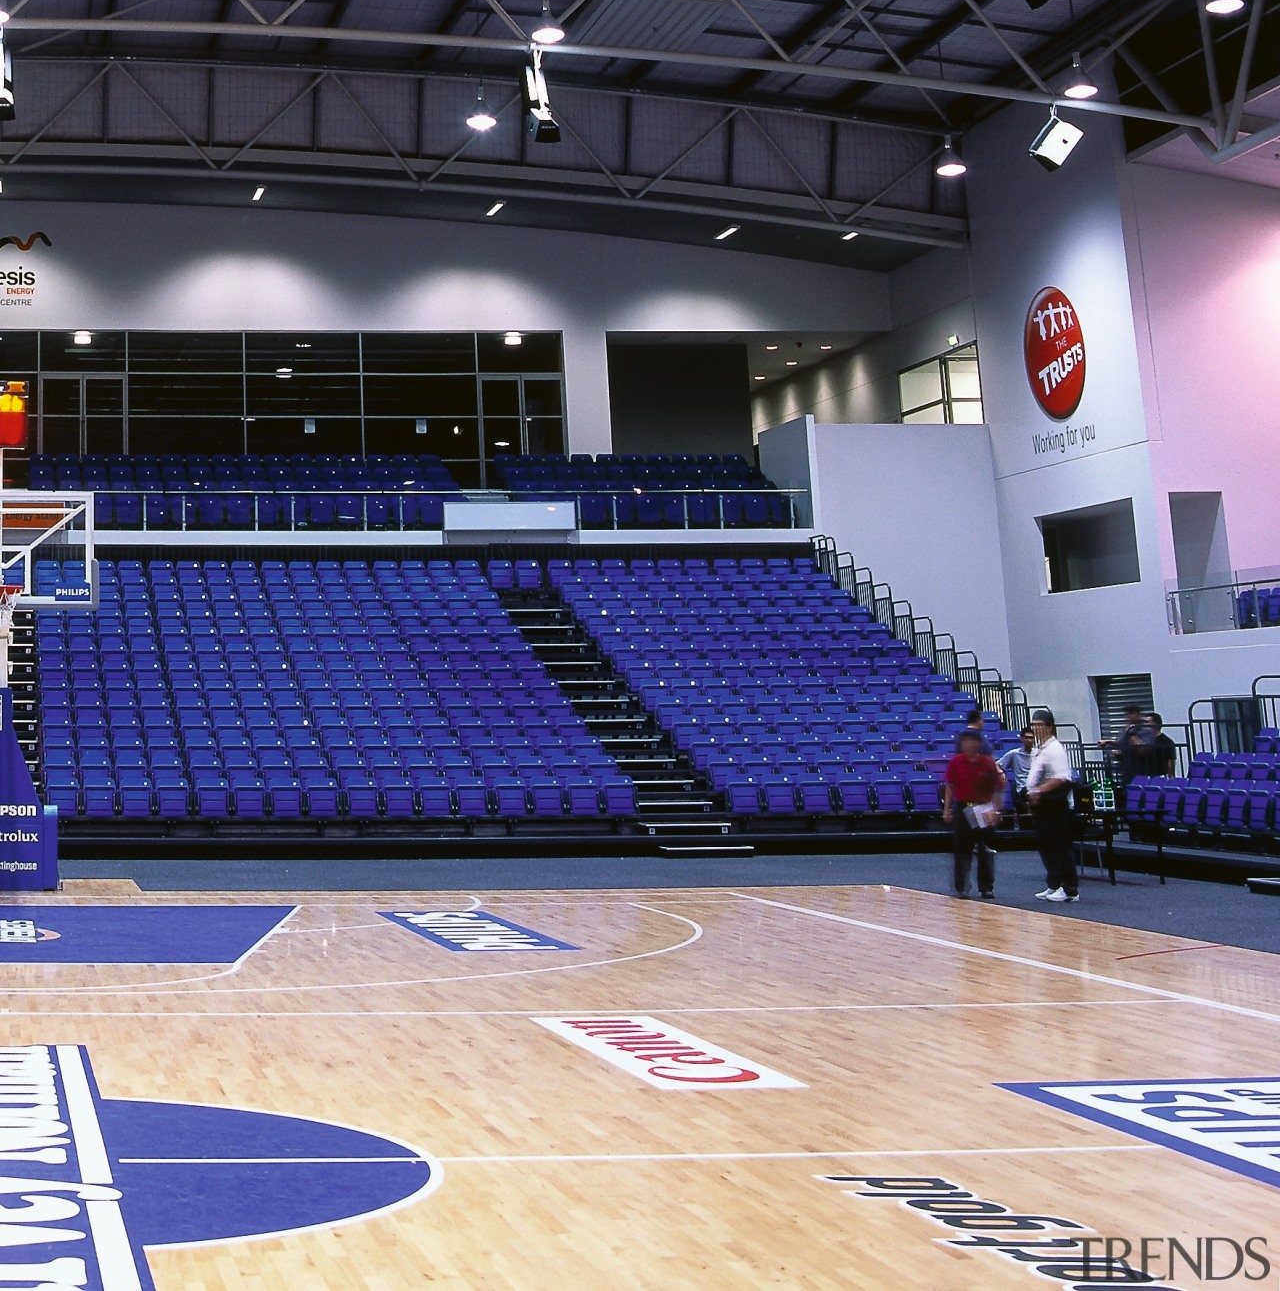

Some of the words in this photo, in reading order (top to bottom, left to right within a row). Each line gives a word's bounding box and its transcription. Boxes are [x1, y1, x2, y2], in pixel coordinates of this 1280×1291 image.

[1055, 337, 1068, 351] THE
[1038, 342, 1083, 396] TRUSTS
[1032, 429, 1066, 455] Working
[1066, 426, 1079, 447] for
[1079, 423, 1096, 447] you
[55, 588, 90, 597] PHILIPS
[393, 911, 559, 950] PHILIPS
[561, 1020, 761, 1083] Canon
